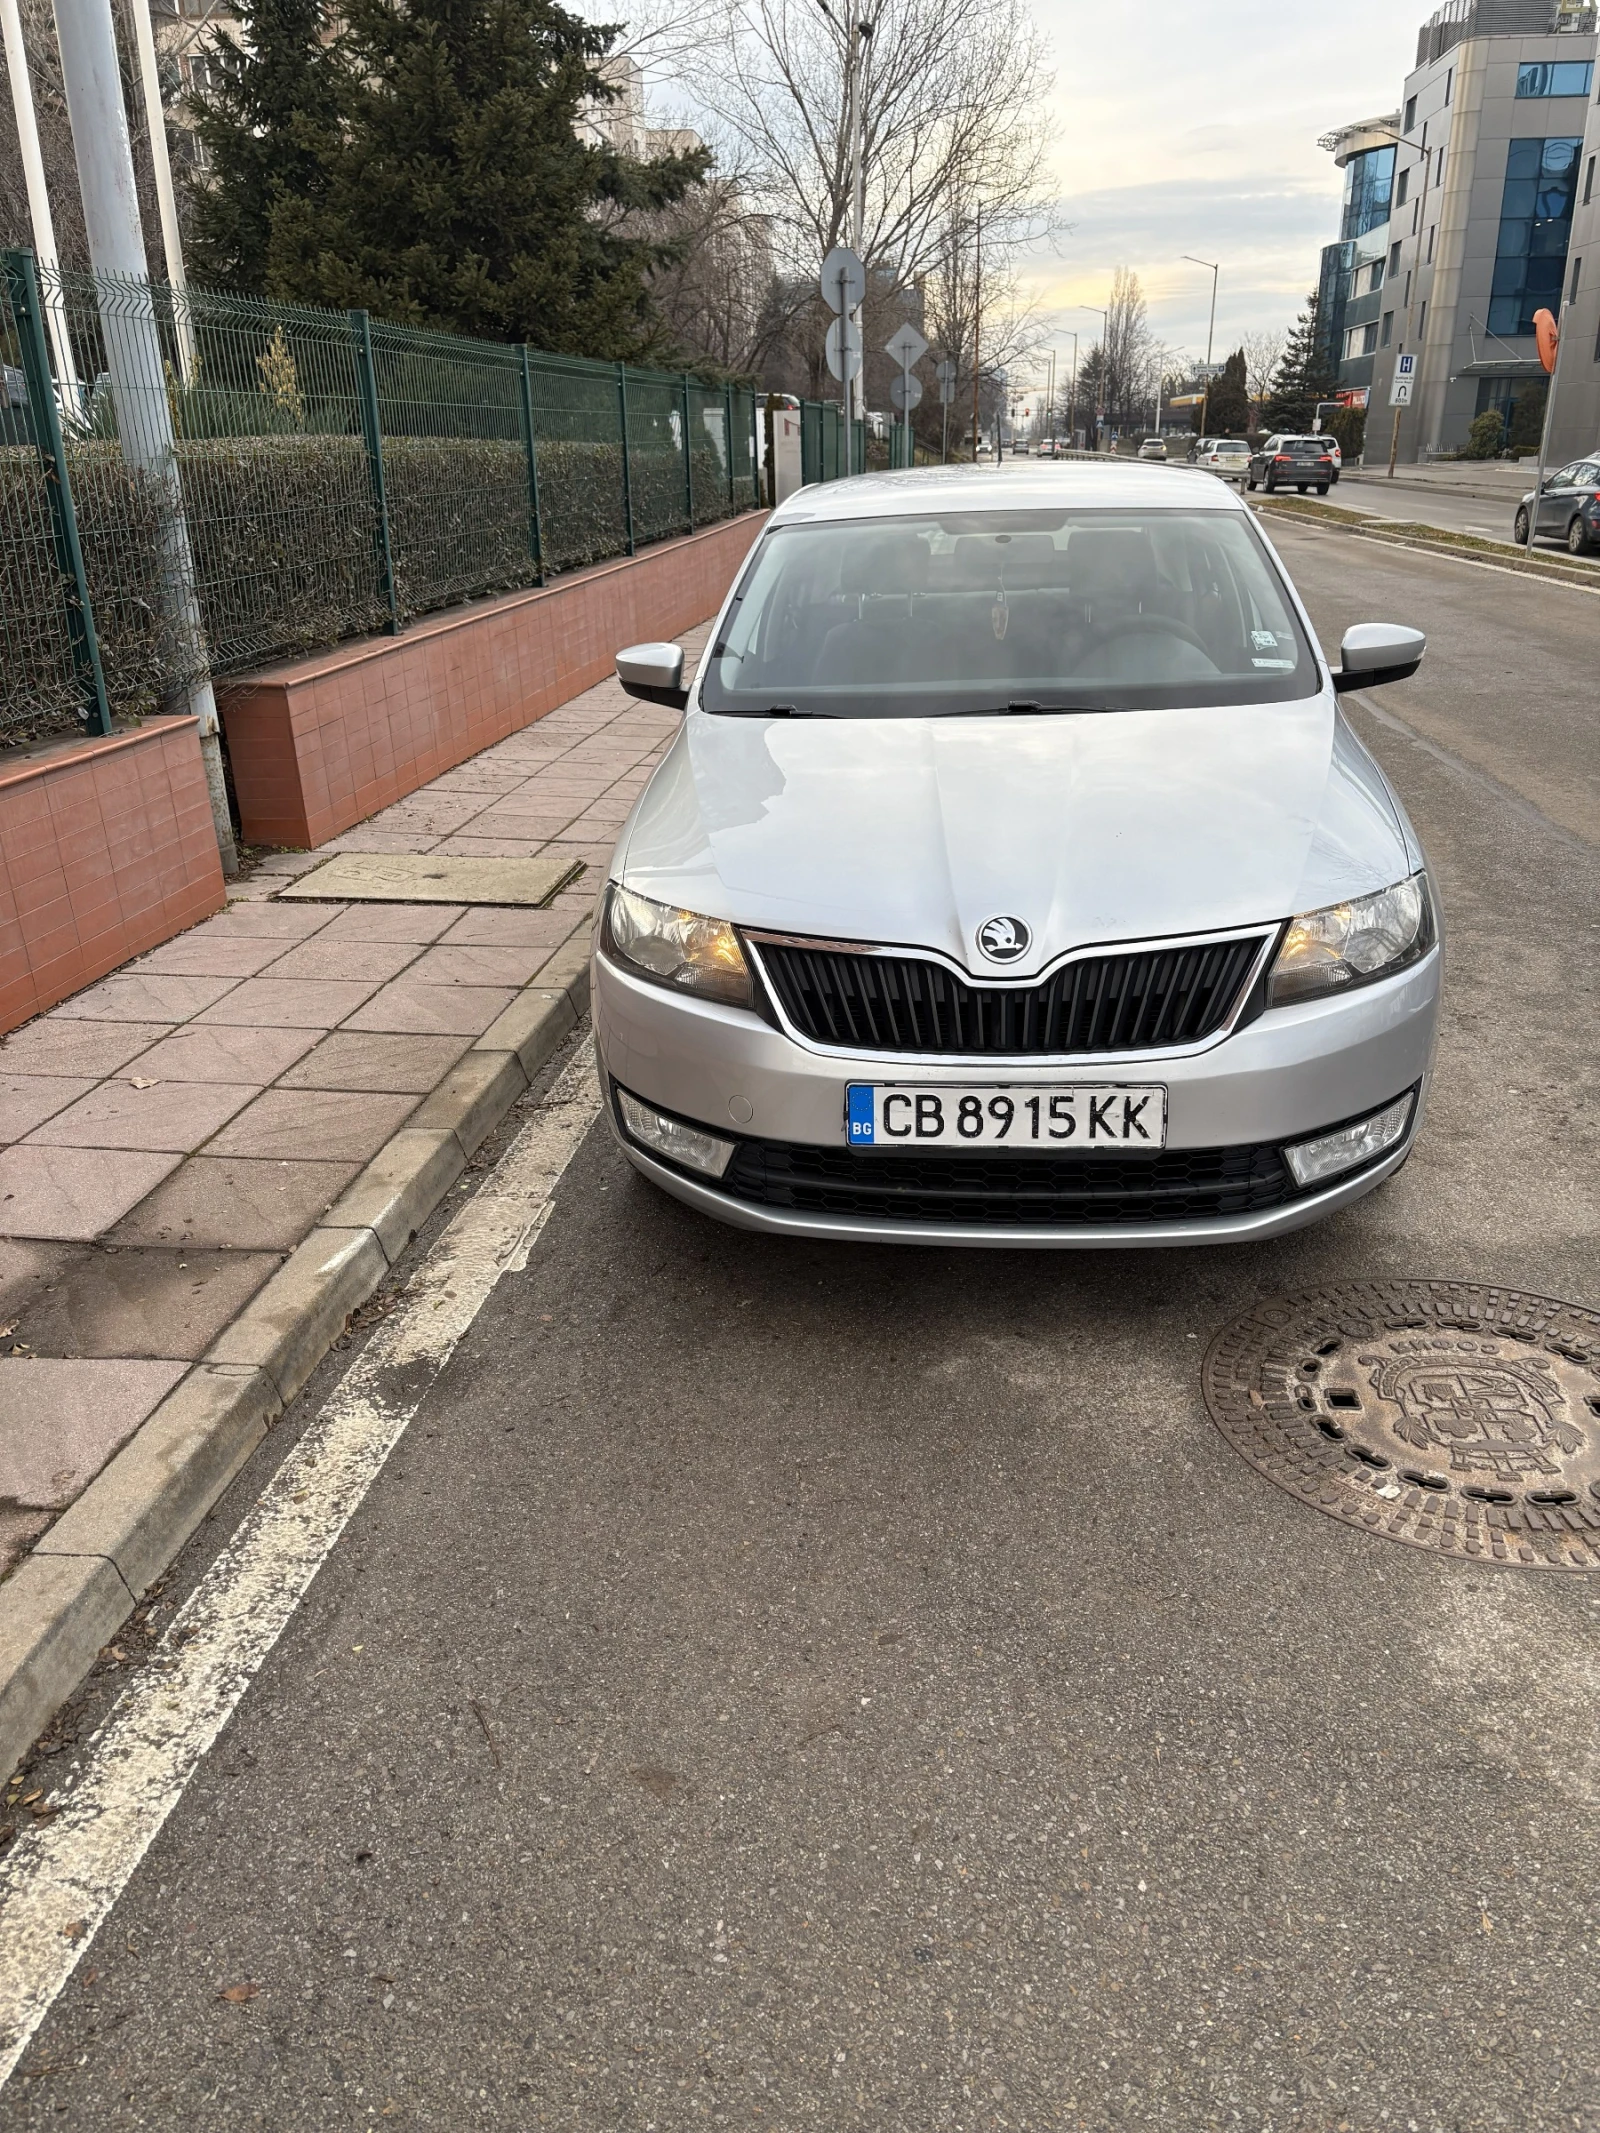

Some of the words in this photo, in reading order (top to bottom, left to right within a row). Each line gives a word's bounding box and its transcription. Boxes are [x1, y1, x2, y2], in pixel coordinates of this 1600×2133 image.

[1402, 357, 1412, 372] H
[883, 1093, 945, 1138] CB
[957, 1095, 1077, 1139] 8915
[1089, 1095, 1151, 1140] KK
[852, 1121, 872, 1135] BG
[1388, 1338, 1500, 1355] СОФИЯ
